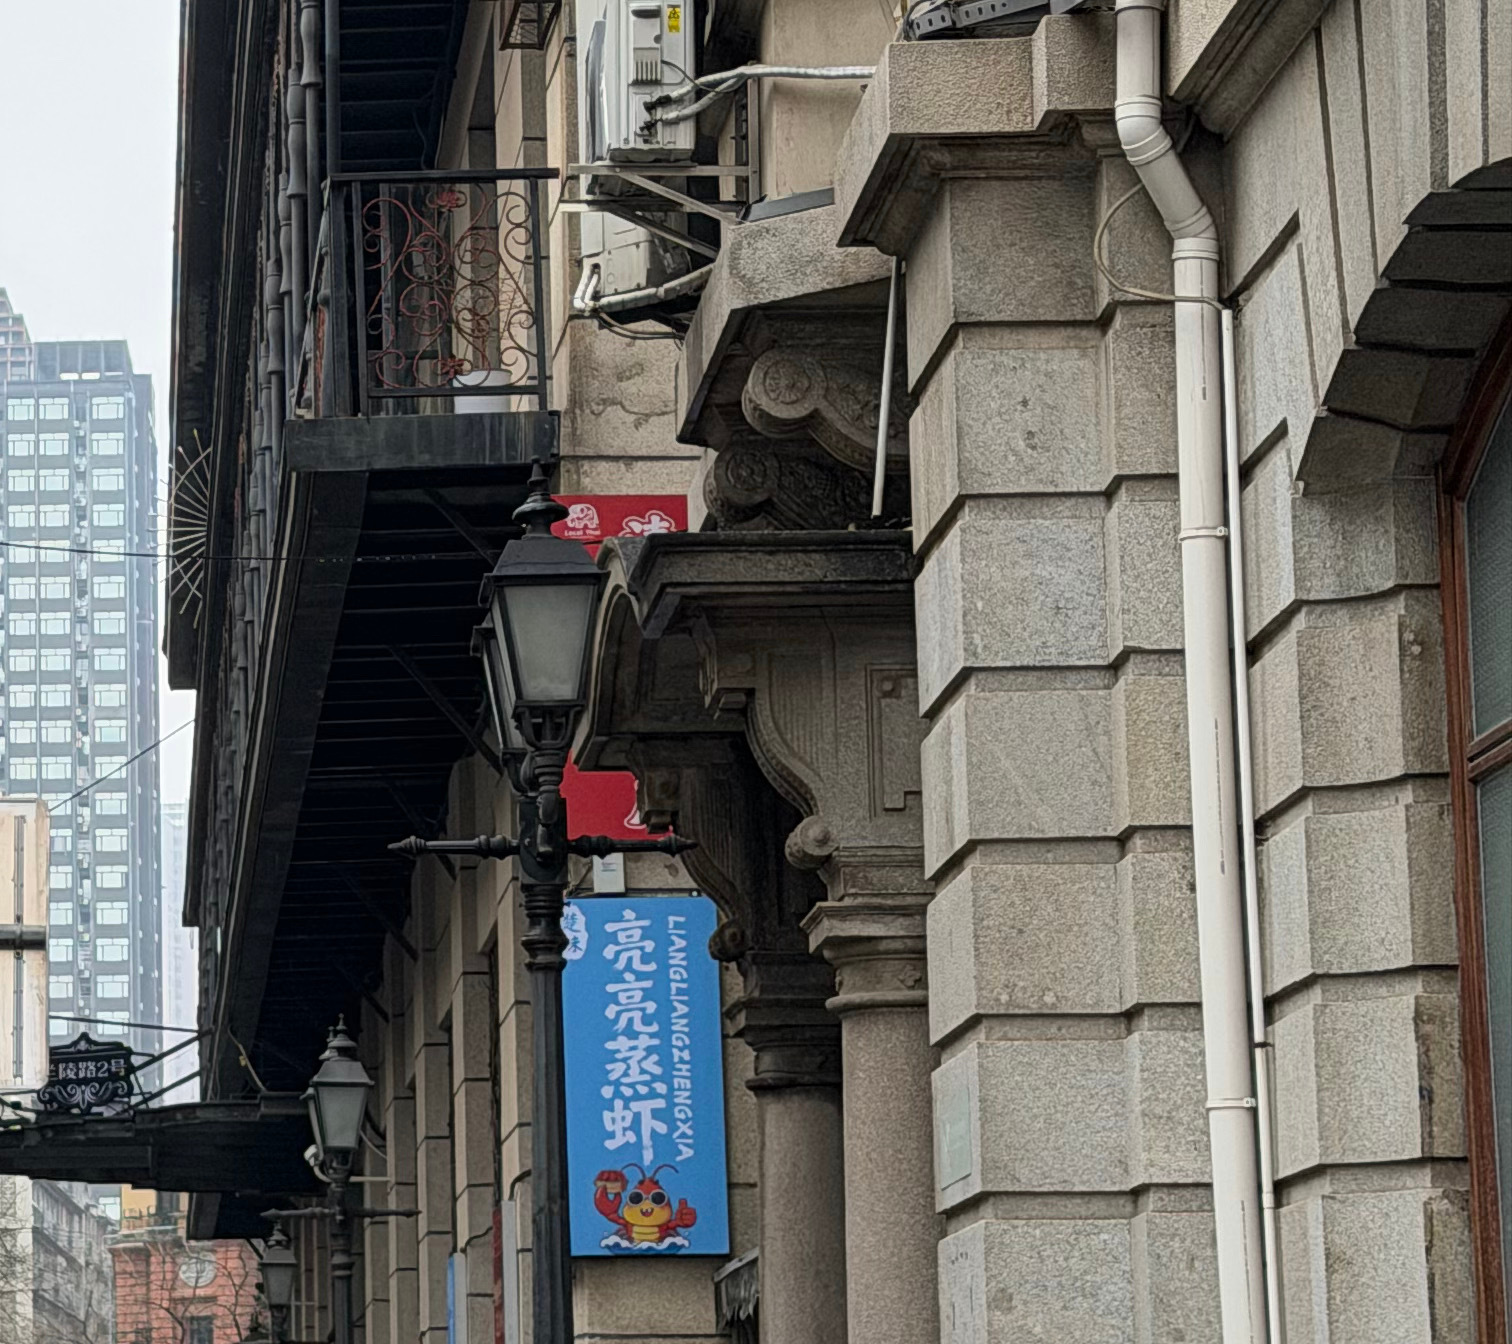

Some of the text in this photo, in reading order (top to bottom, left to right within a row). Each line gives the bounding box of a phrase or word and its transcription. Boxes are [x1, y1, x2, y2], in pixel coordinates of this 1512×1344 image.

[600, 908, 668, 1166] 亮亮蒸虾
[666, 915, 696, 1164] LIANGLIANGZHENGXIA
